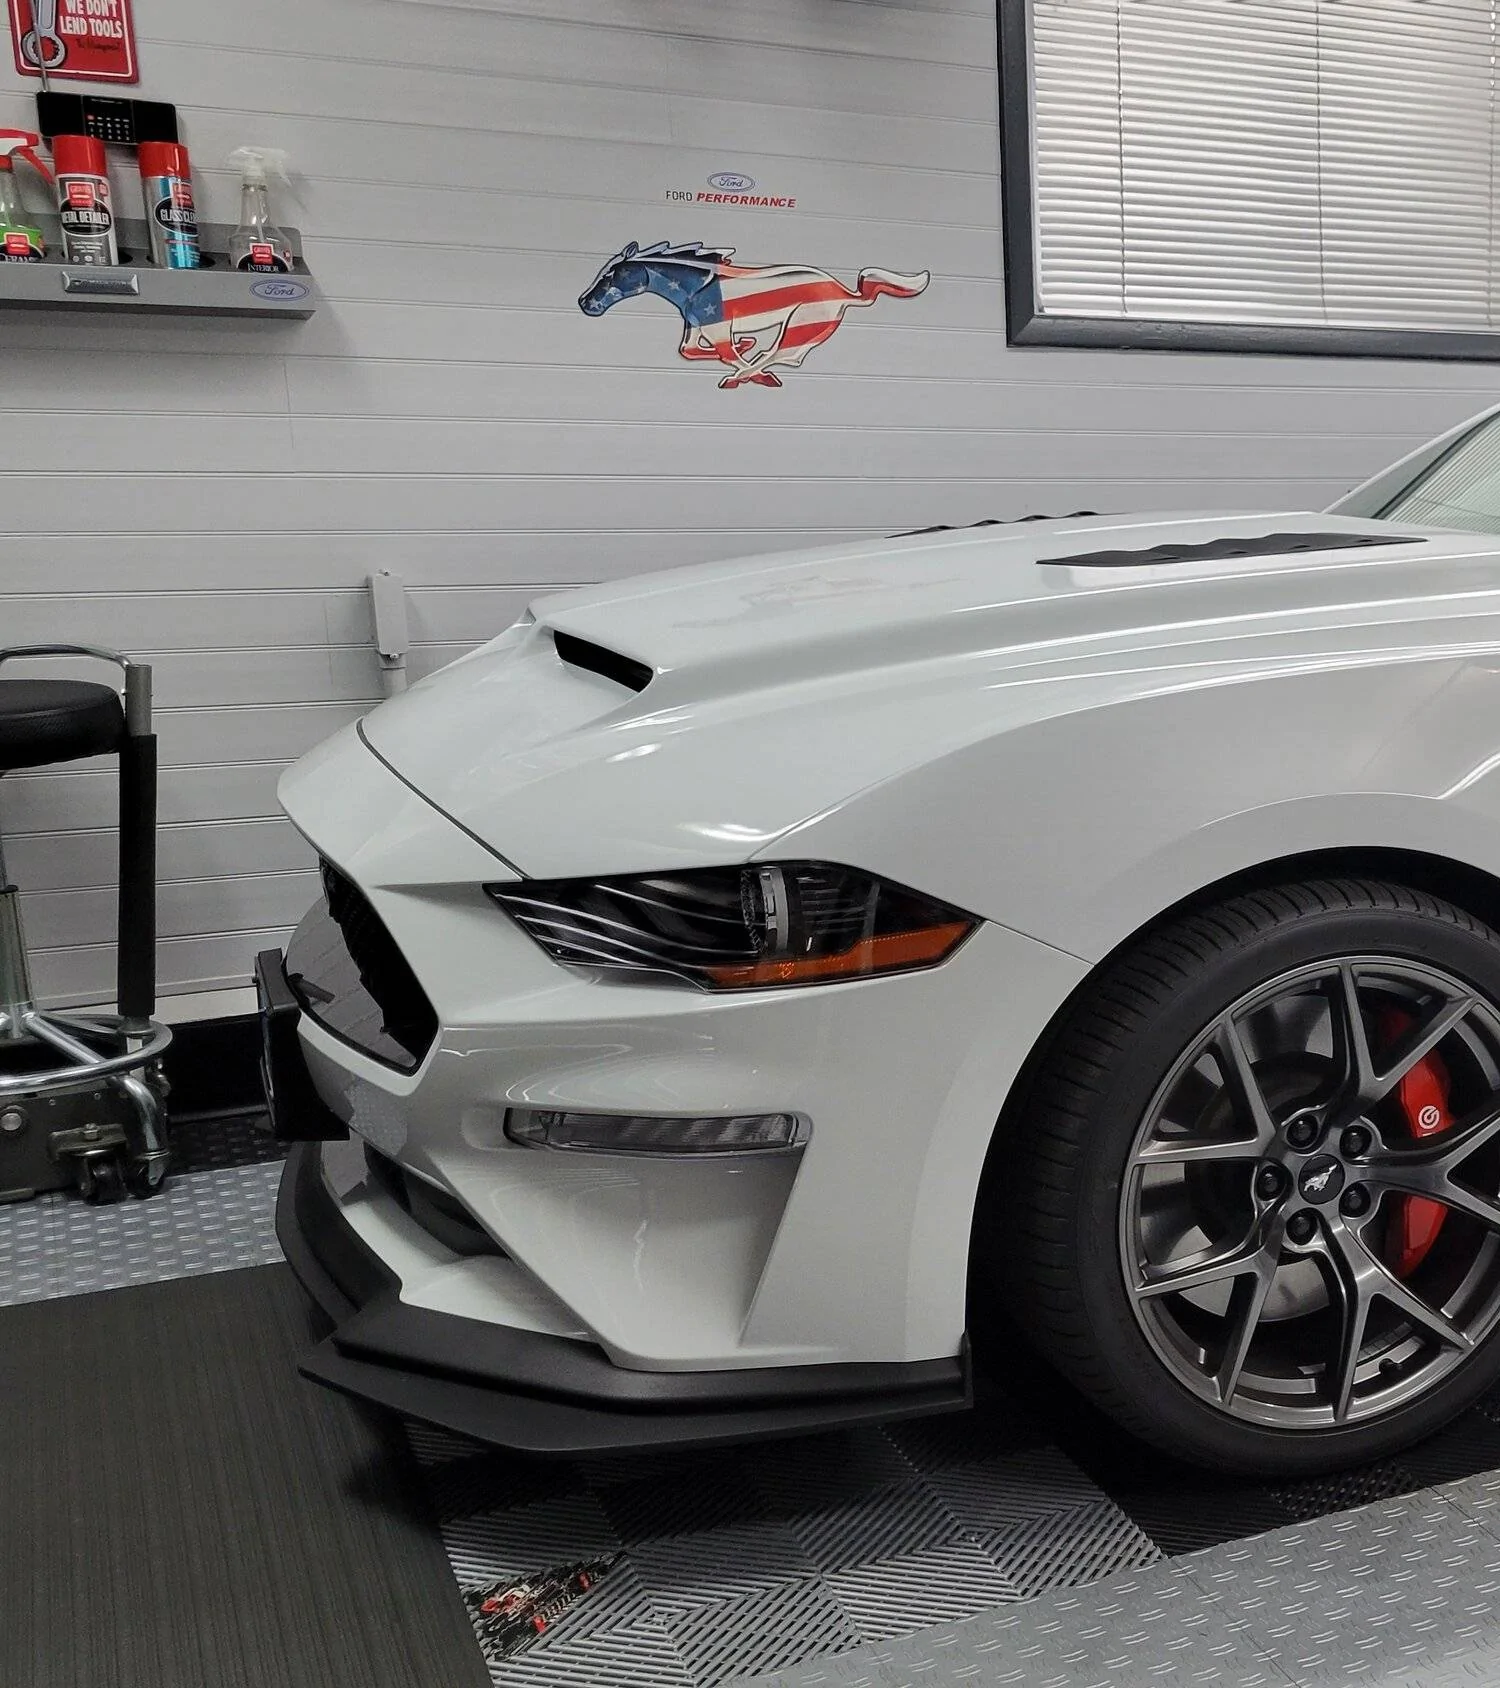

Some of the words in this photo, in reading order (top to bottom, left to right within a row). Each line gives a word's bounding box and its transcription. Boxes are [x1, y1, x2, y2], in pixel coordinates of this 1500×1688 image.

[60, 16, 88, 36] LEND
[90, 18, 123, 39] TOOLS
[719, 176, 744, 188] Ford
[666, 190, 693, 202] FORD
[696, 192, 796, 208] PERFORMANCE
[264, 283, 296, 296] Ford
